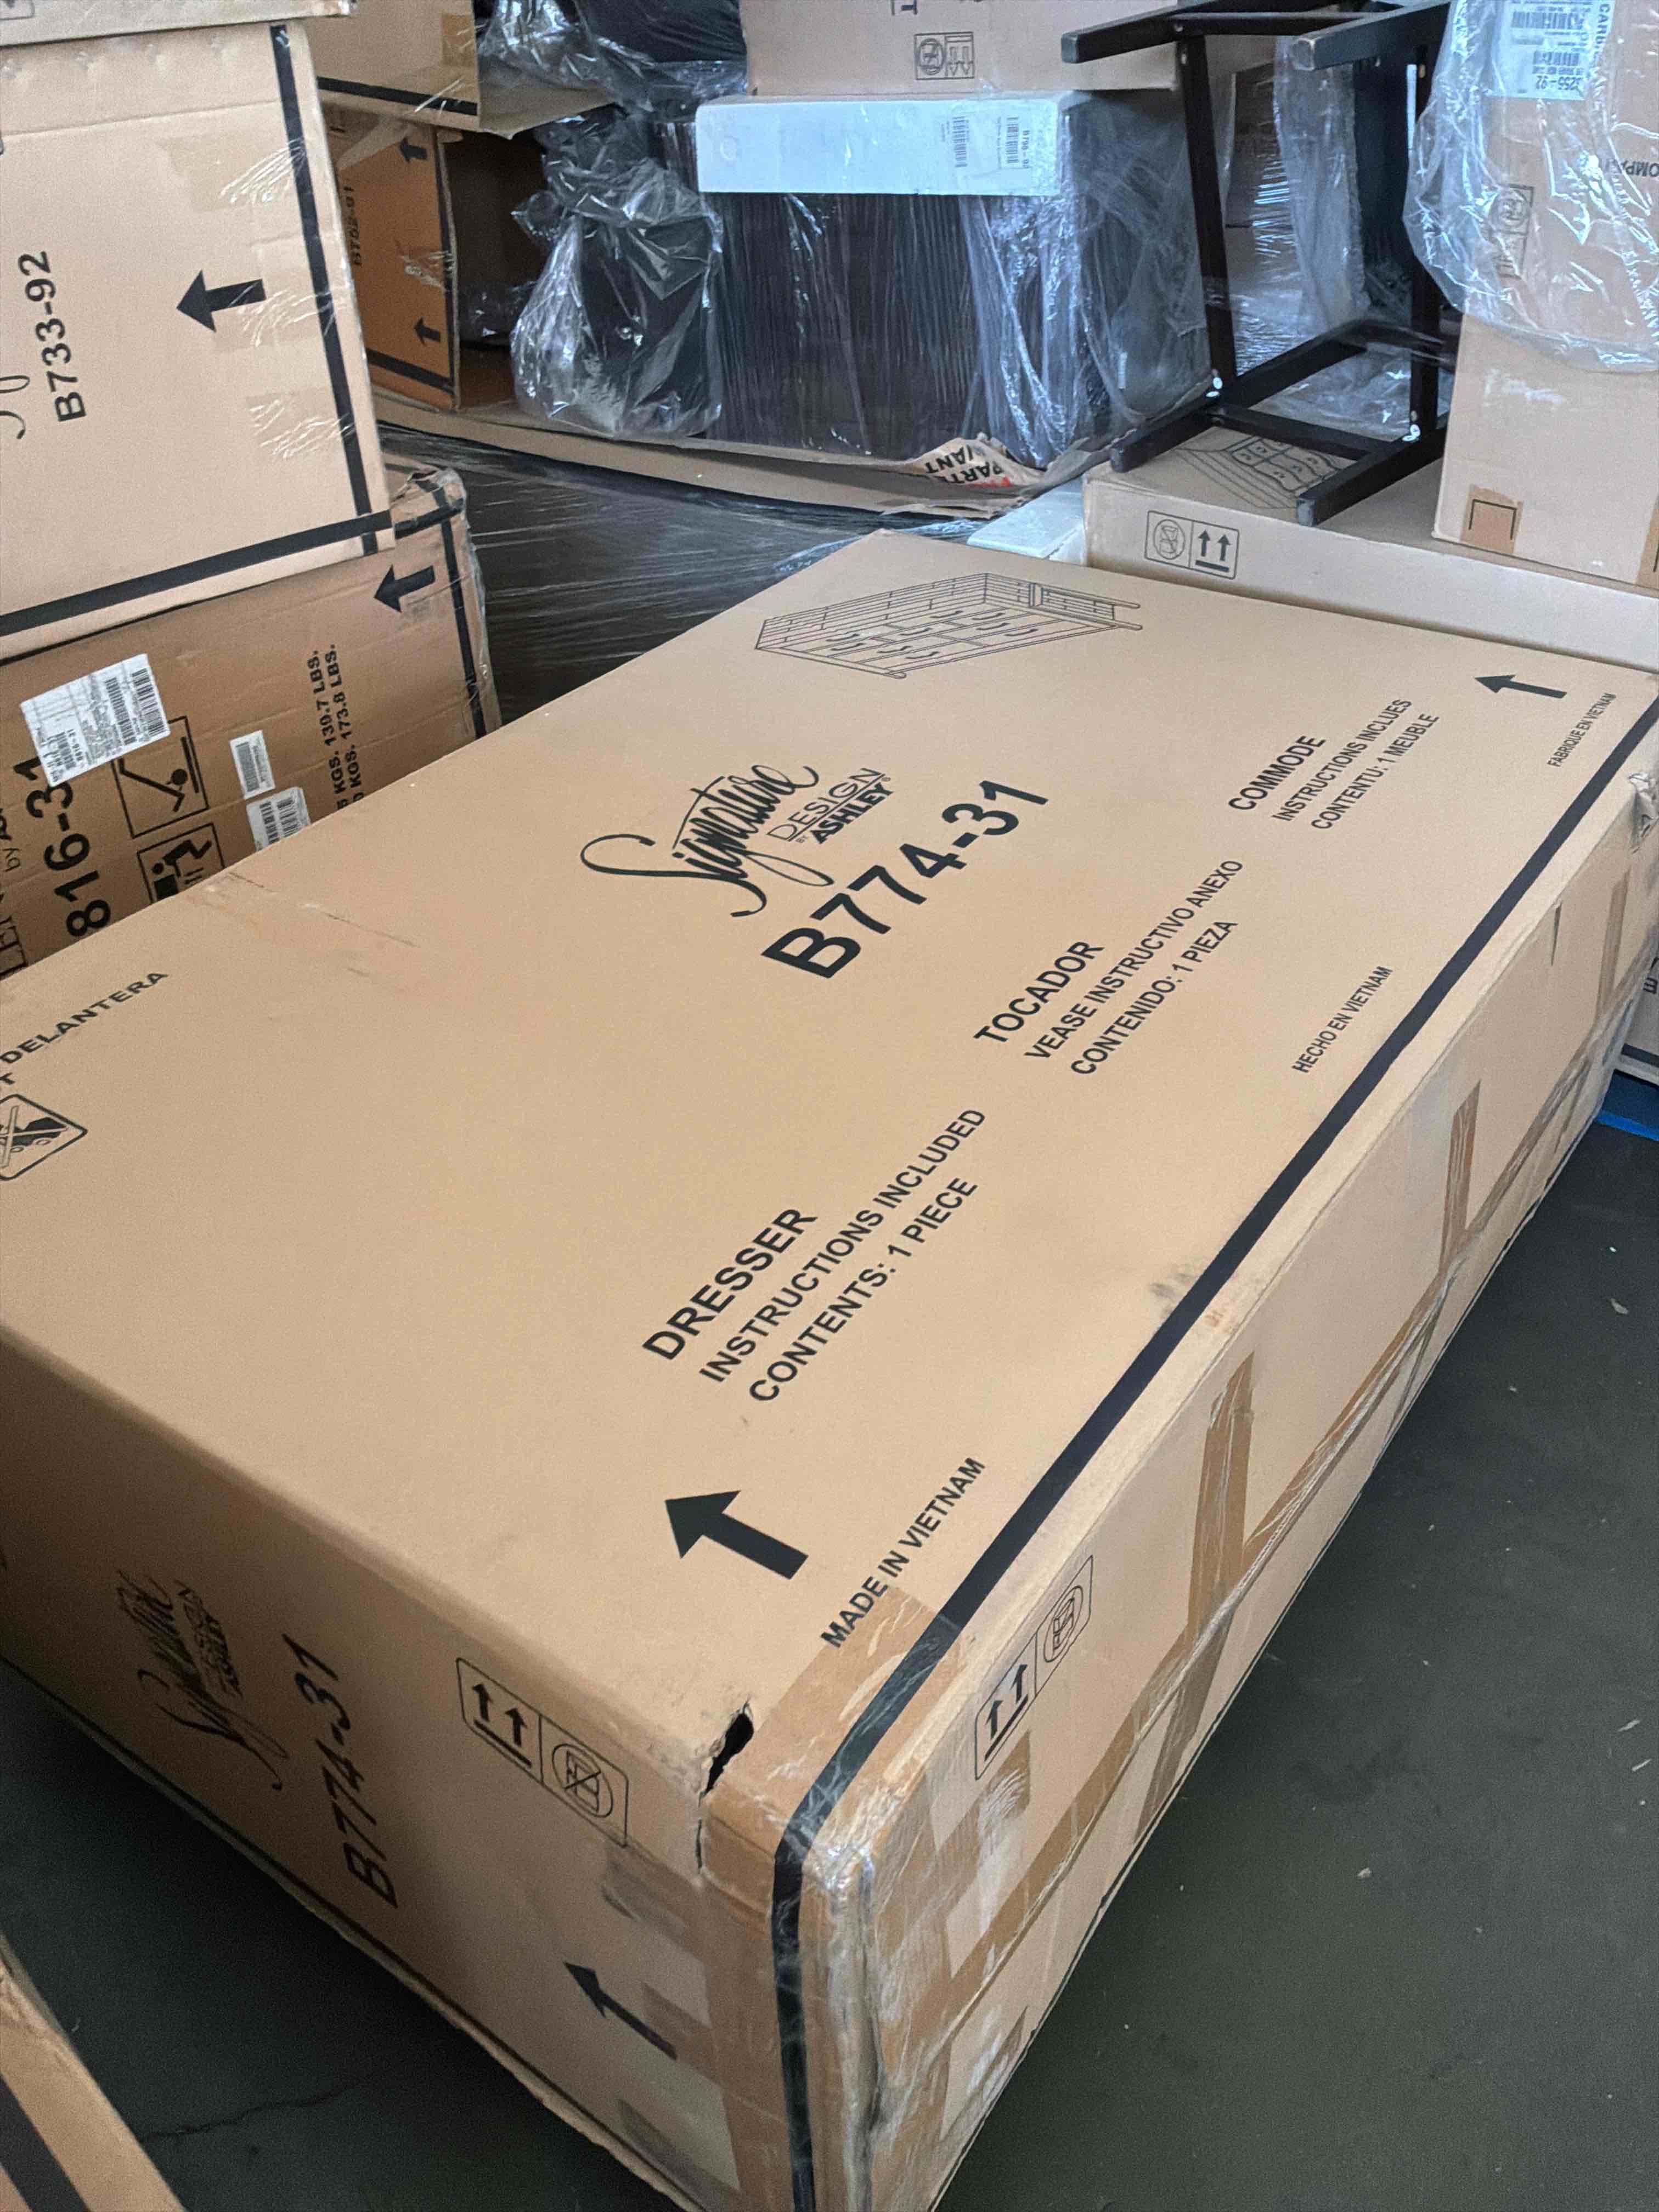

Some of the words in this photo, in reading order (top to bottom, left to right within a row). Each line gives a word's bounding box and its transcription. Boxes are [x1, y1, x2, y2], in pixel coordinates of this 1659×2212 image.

[18, 251, 86, 422] B733-92
[307, 650, 325, 694] LBS.
[325, 644, 342, 687] LBS.
[333, 692, 352, 740] 173.8
[1228, 735, 1325, 811] COMMODE
[1271, 741, 1368, 821] INSTRUCTIONS
[1359, 698, 1412, 743] INCLUES
[1378, 756, 1395, 764] 1
[1389, 713, 1440, 758] MEUBLE
[1547, 730, 1579, 767] FABRIQUE
[1575, 718, 1591, 733] EN
[1585, 692, 1617, 720] VIETNAM
[580, 765, 834, 917] Signature
[766, 768, 883, 840] DESIGN
[761, 780, 1049, 979] B774-31
[0, 972, 168, 1064] DELANTERA
[973, 941, 1105, 1044] TOCADOR
[1024, 994, 1097, 1061] VEASE
[1085, 907, 1194, 1007] INSTRUCTIVO
[1186, 860, 1243, 909] ANEXO
[1070, 975, 1183, 1075] CONTENIDO:
[1171, 964, 1193, 974] 1
[1182, 918, 1238, 963] PIEZA
[1291, 1031, 1338, 1073] HECHO
[1329, 1010, 1353, 1033] EN
[1345, 966, 1393, 1015] VIETNAM
[642, 1209, 818, 1360] DRESSER
[699, 1209, 885, 1382] INSTRUCTIONS
[873, 1109, 986, 1208] INCLUDED
[749, 1263, 896, 1401] CONTENTS:
[888, 1244, 912, 1257] 1
[901, 1177, 978, 1243] PIECE
[820, 1576, 889, 1648] MADE
[878, 1550, 910, 1578] IN
[898, 1457, 986, 1548] VIETNAM
[281, 1633, 398, 1909] B774-31
